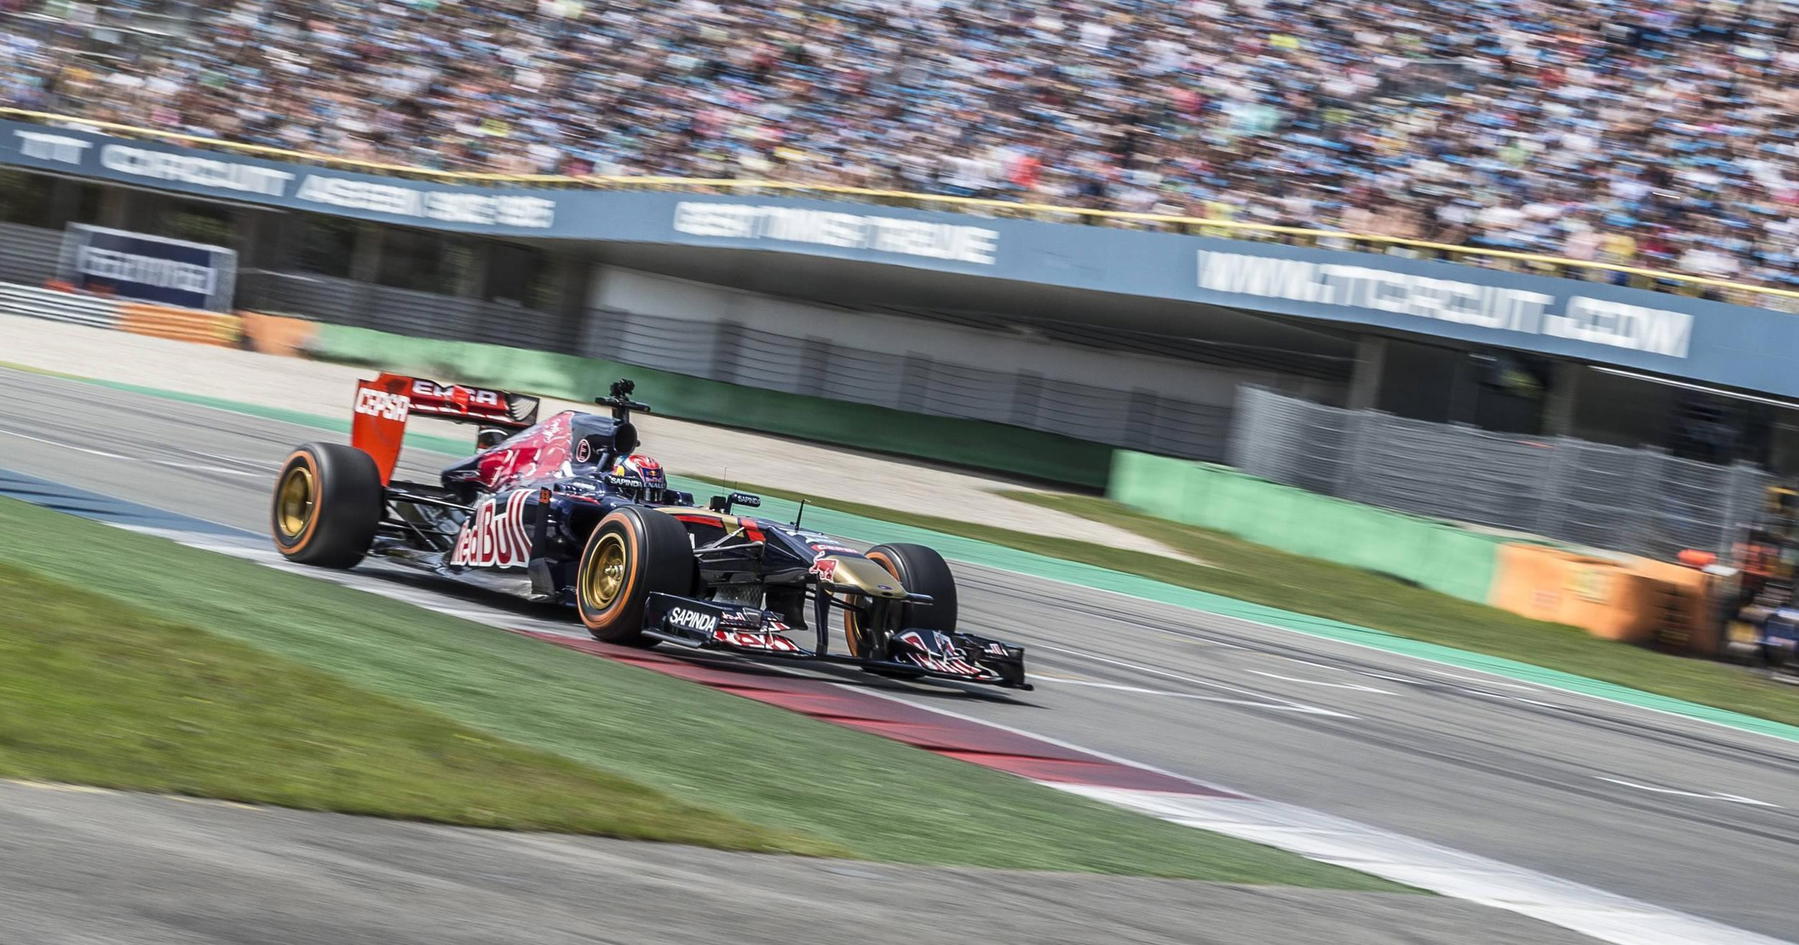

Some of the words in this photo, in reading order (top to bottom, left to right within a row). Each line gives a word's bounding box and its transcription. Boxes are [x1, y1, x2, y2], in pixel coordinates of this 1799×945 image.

[14, 129, 92, 165] TT
[101, 143, 295, 197] CIRCUIT
[355, 387, 411, 423] CEPSA
[669, 606, 717, 632] SAPINDA
